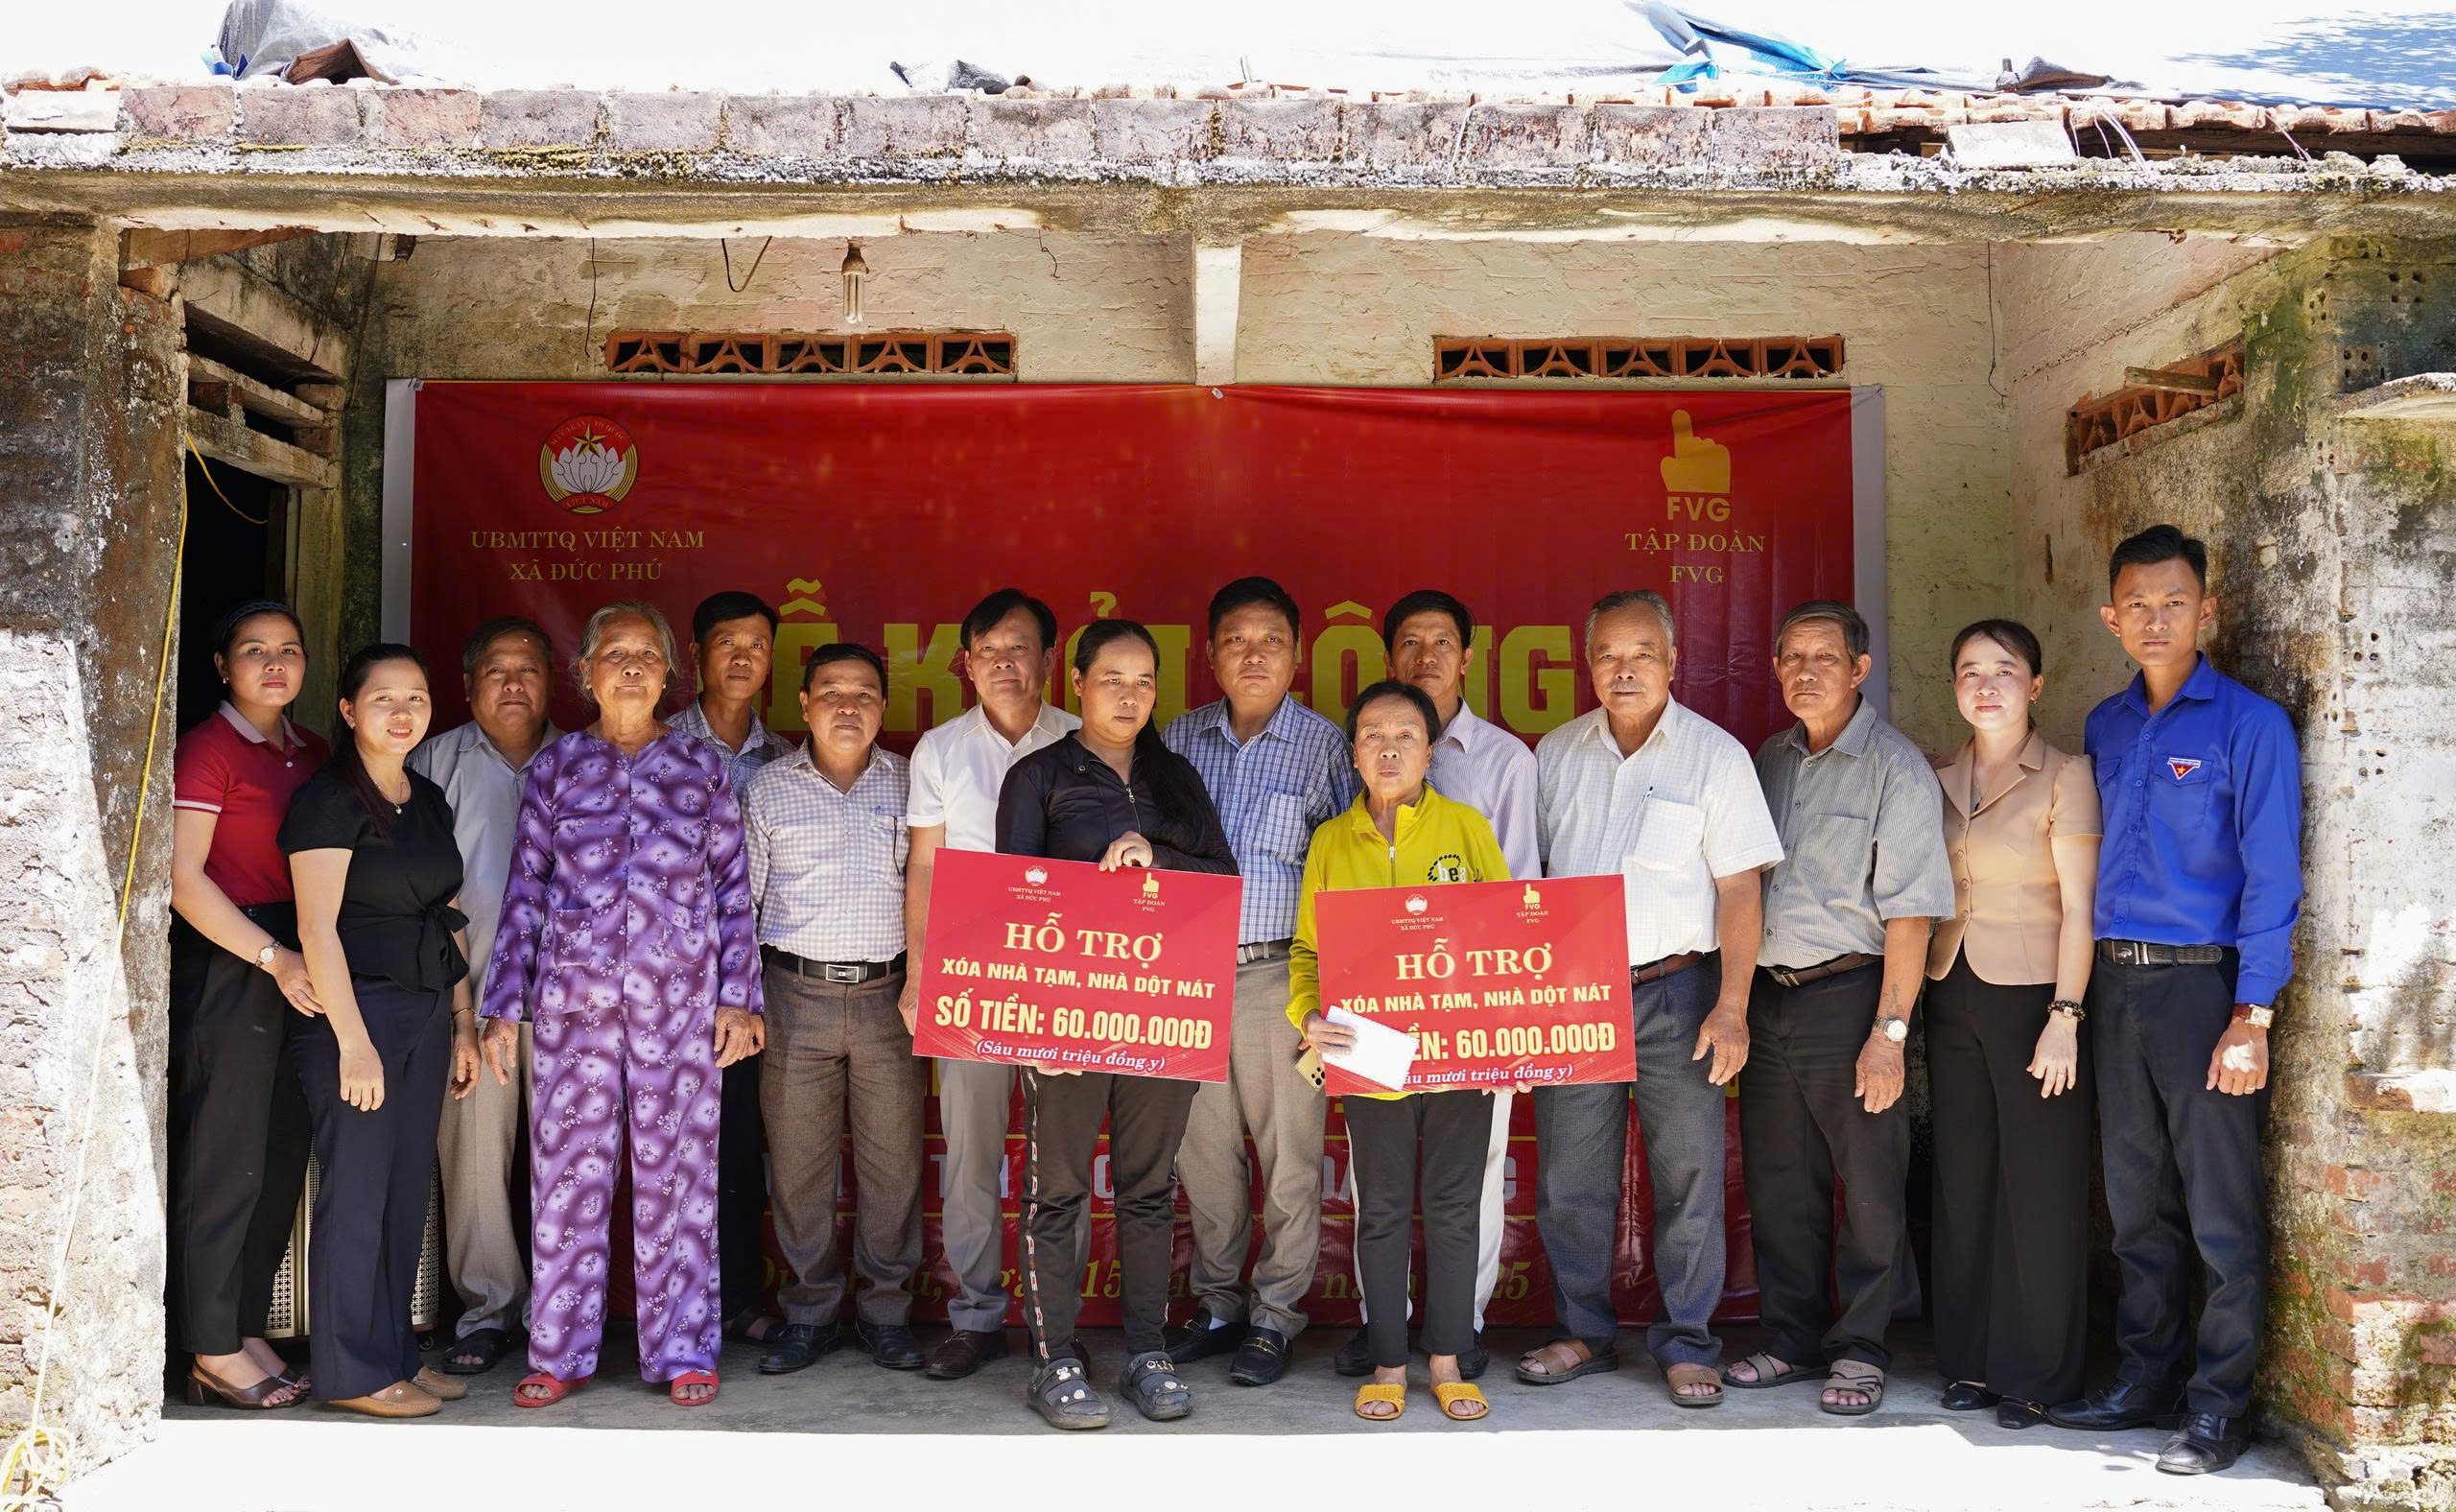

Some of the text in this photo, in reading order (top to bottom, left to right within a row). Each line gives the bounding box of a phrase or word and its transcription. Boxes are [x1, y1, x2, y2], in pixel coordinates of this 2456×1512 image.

[1666, 496, 1731, 522] FVG
[470, 526, 705, 553] UBMTTQ VIỆT NAM
[1624, 528, 1766, 555] TẬP ĐOÀN
[509, 557, 663, 580] XÃ ĐỨC PHÚ
[1669, 565, 1725, 584] FVG
[1003, 911, 1164, 969] HỖ TRỢ
[1394, 937, 1552, 980] HỖ TRỢ
[941, 957, 1216, 999] XÓA NHÀ TẠM, NHÀ DỘT NÁT
[1340, 982, 1612, 1013] XÓA NHÀ TẠM, NHÀ DỘT NÁT
[934, 988, 1213, 1050] SỐ TIỀN: 60.000.000Đ
[976, 1039, 1166, 1072] (Sáu mươi triệu đồng y)
[1456, 1022, 1616, 1060] 60.000.000Đ
[1426, 1069, 1466, 1083] mươi
[1471, 1065, 1509, 1081] triệu
[1514, 1062, 1554, 1080] đồng
[1556, 1063, 1572, 1079] y)
